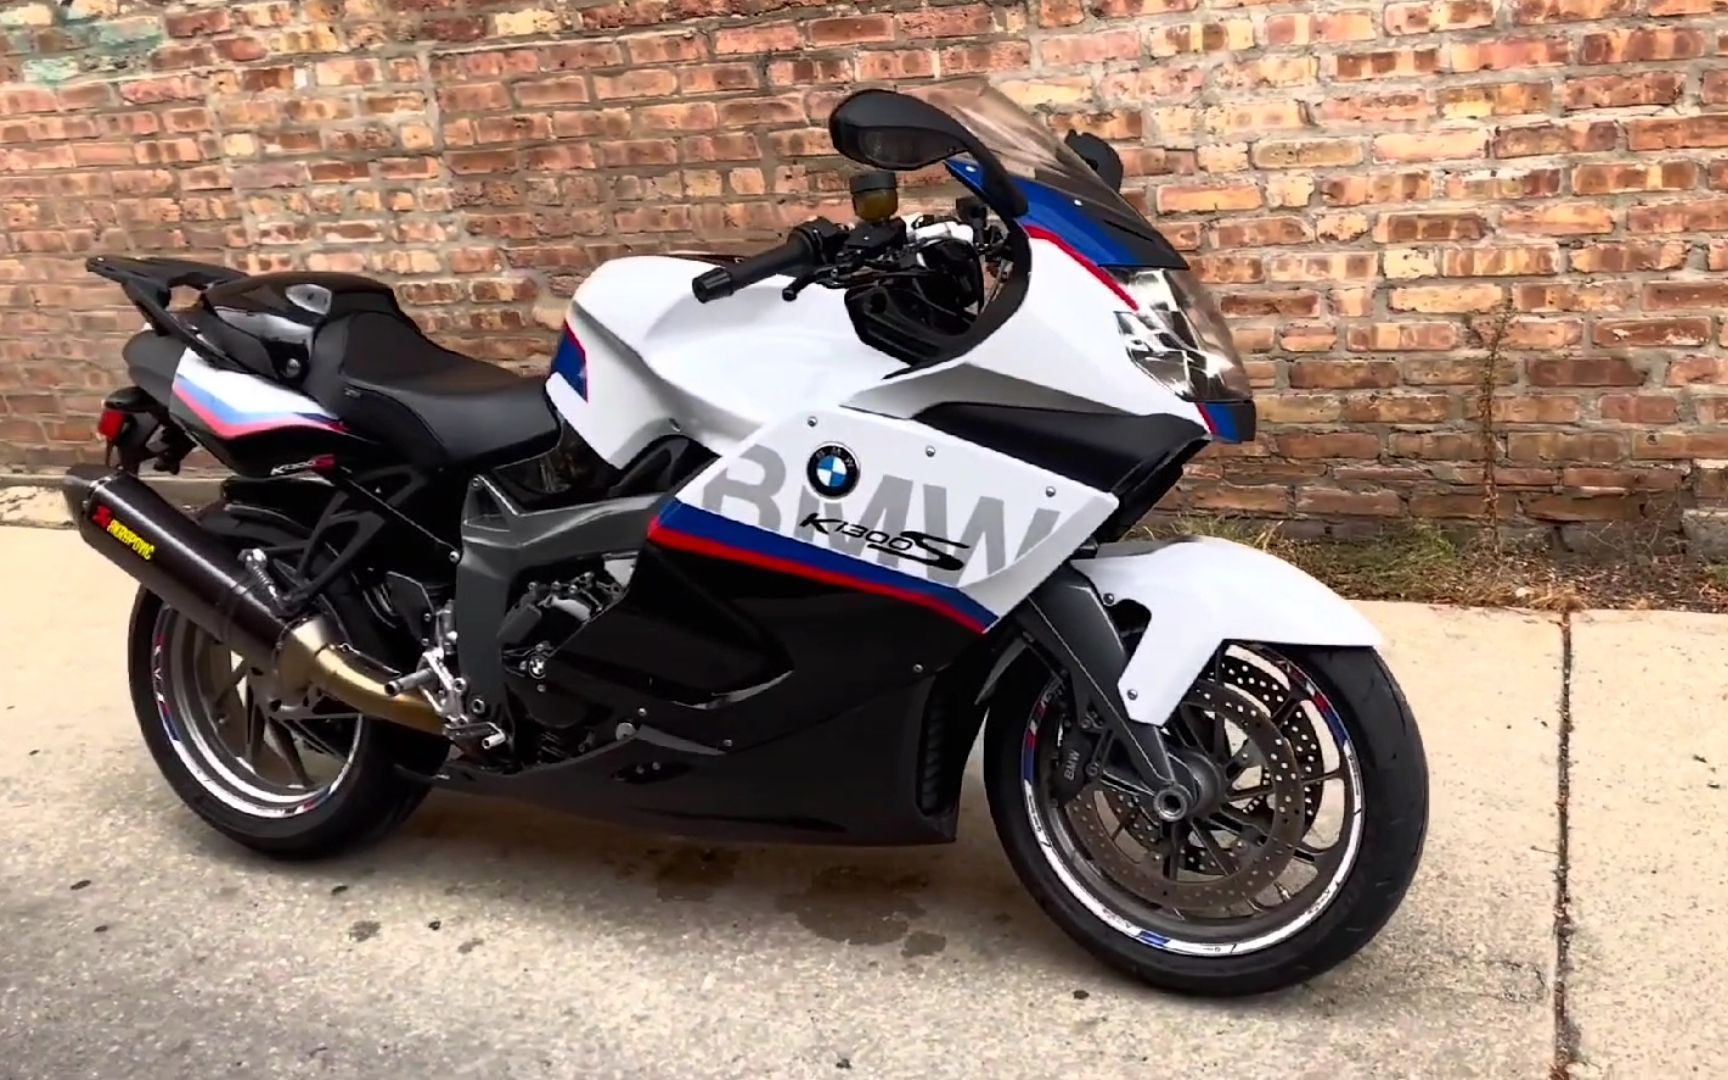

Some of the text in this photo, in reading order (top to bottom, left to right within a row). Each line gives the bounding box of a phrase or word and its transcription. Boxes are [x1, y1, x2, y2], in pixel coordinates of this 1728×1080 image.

[702, 444, 1061, 587] BMW
[799, 513, 970, 571] K1300S
[1064, 746, 1080, 780] BMW
